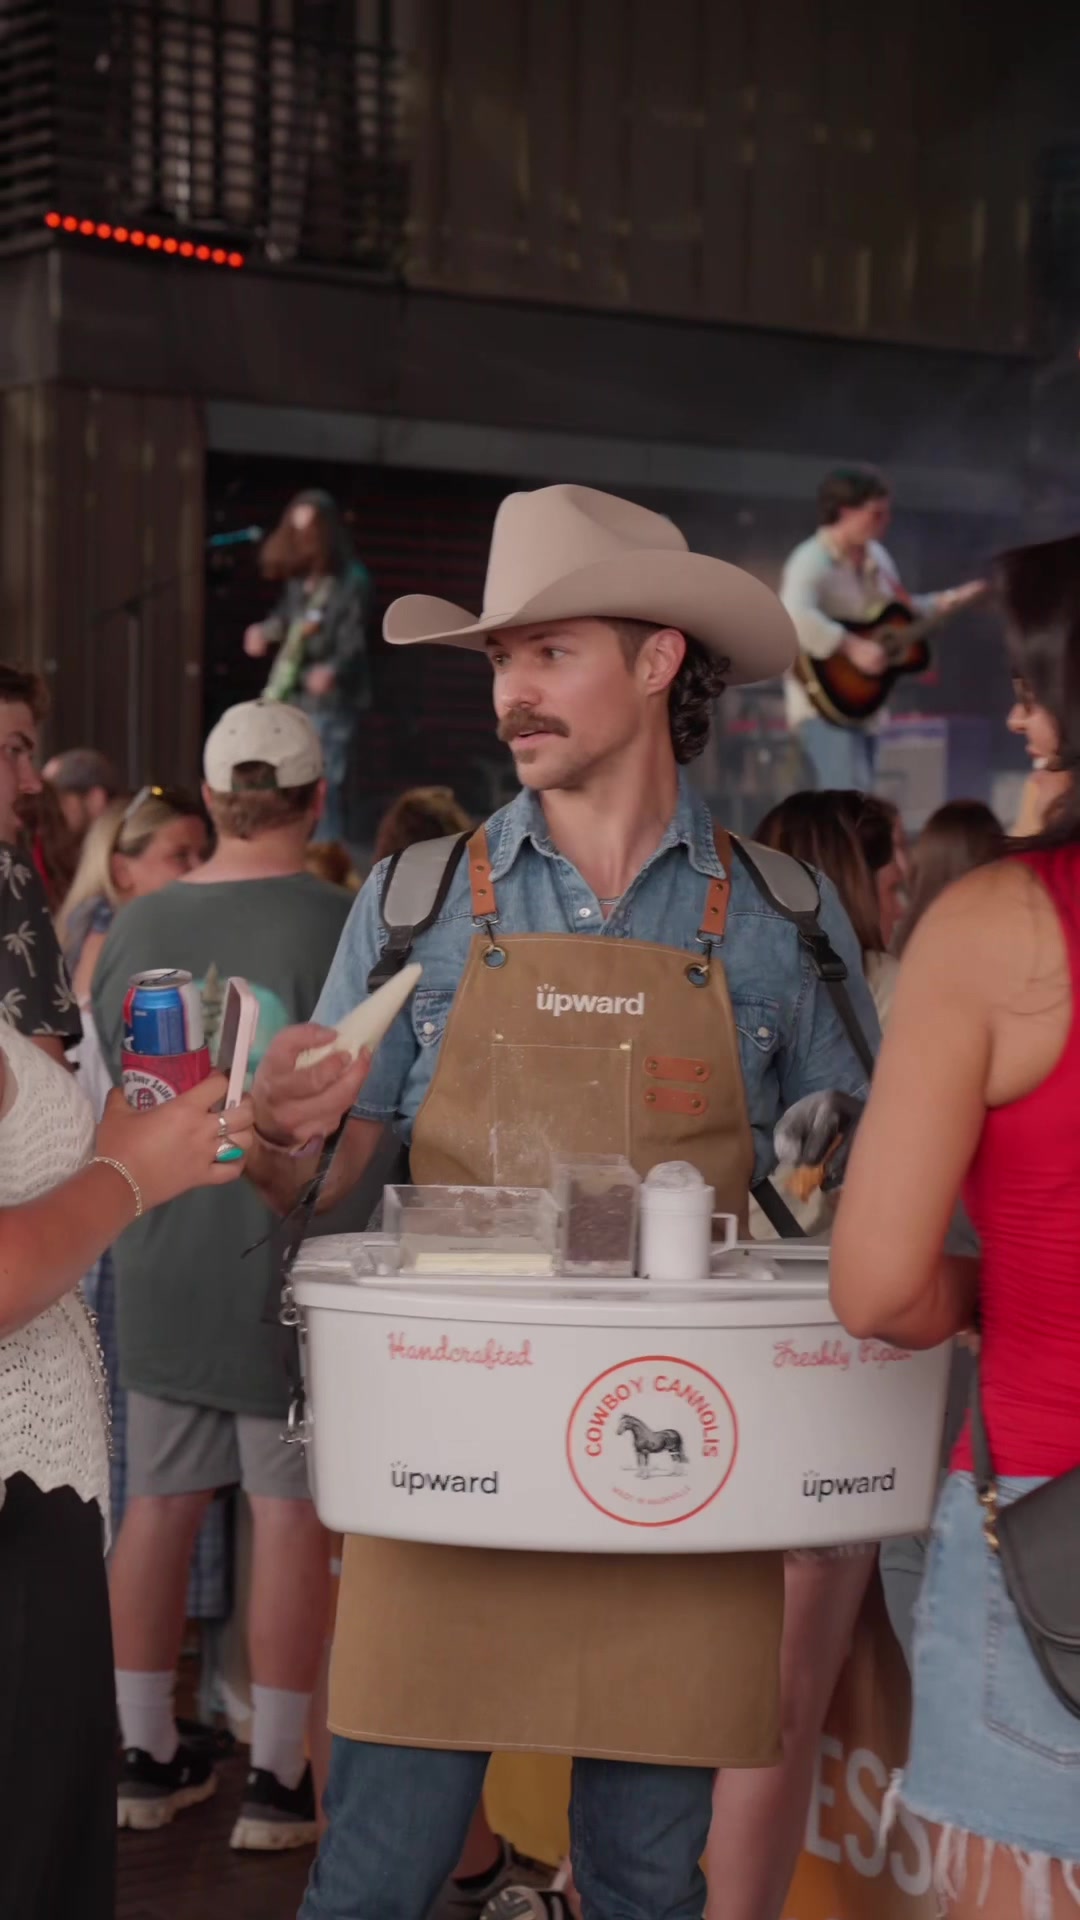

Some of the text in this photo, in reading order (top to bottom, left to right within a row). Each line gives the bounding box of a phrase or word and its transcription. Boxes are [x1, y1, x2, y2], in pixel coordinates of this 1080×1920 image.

[387, 1331, 533, 1370] Handcrafted
[773, 1339, 851, 1371] Freshly
[585, 1375, 720, 1457] COWBOY CANNOLIS
